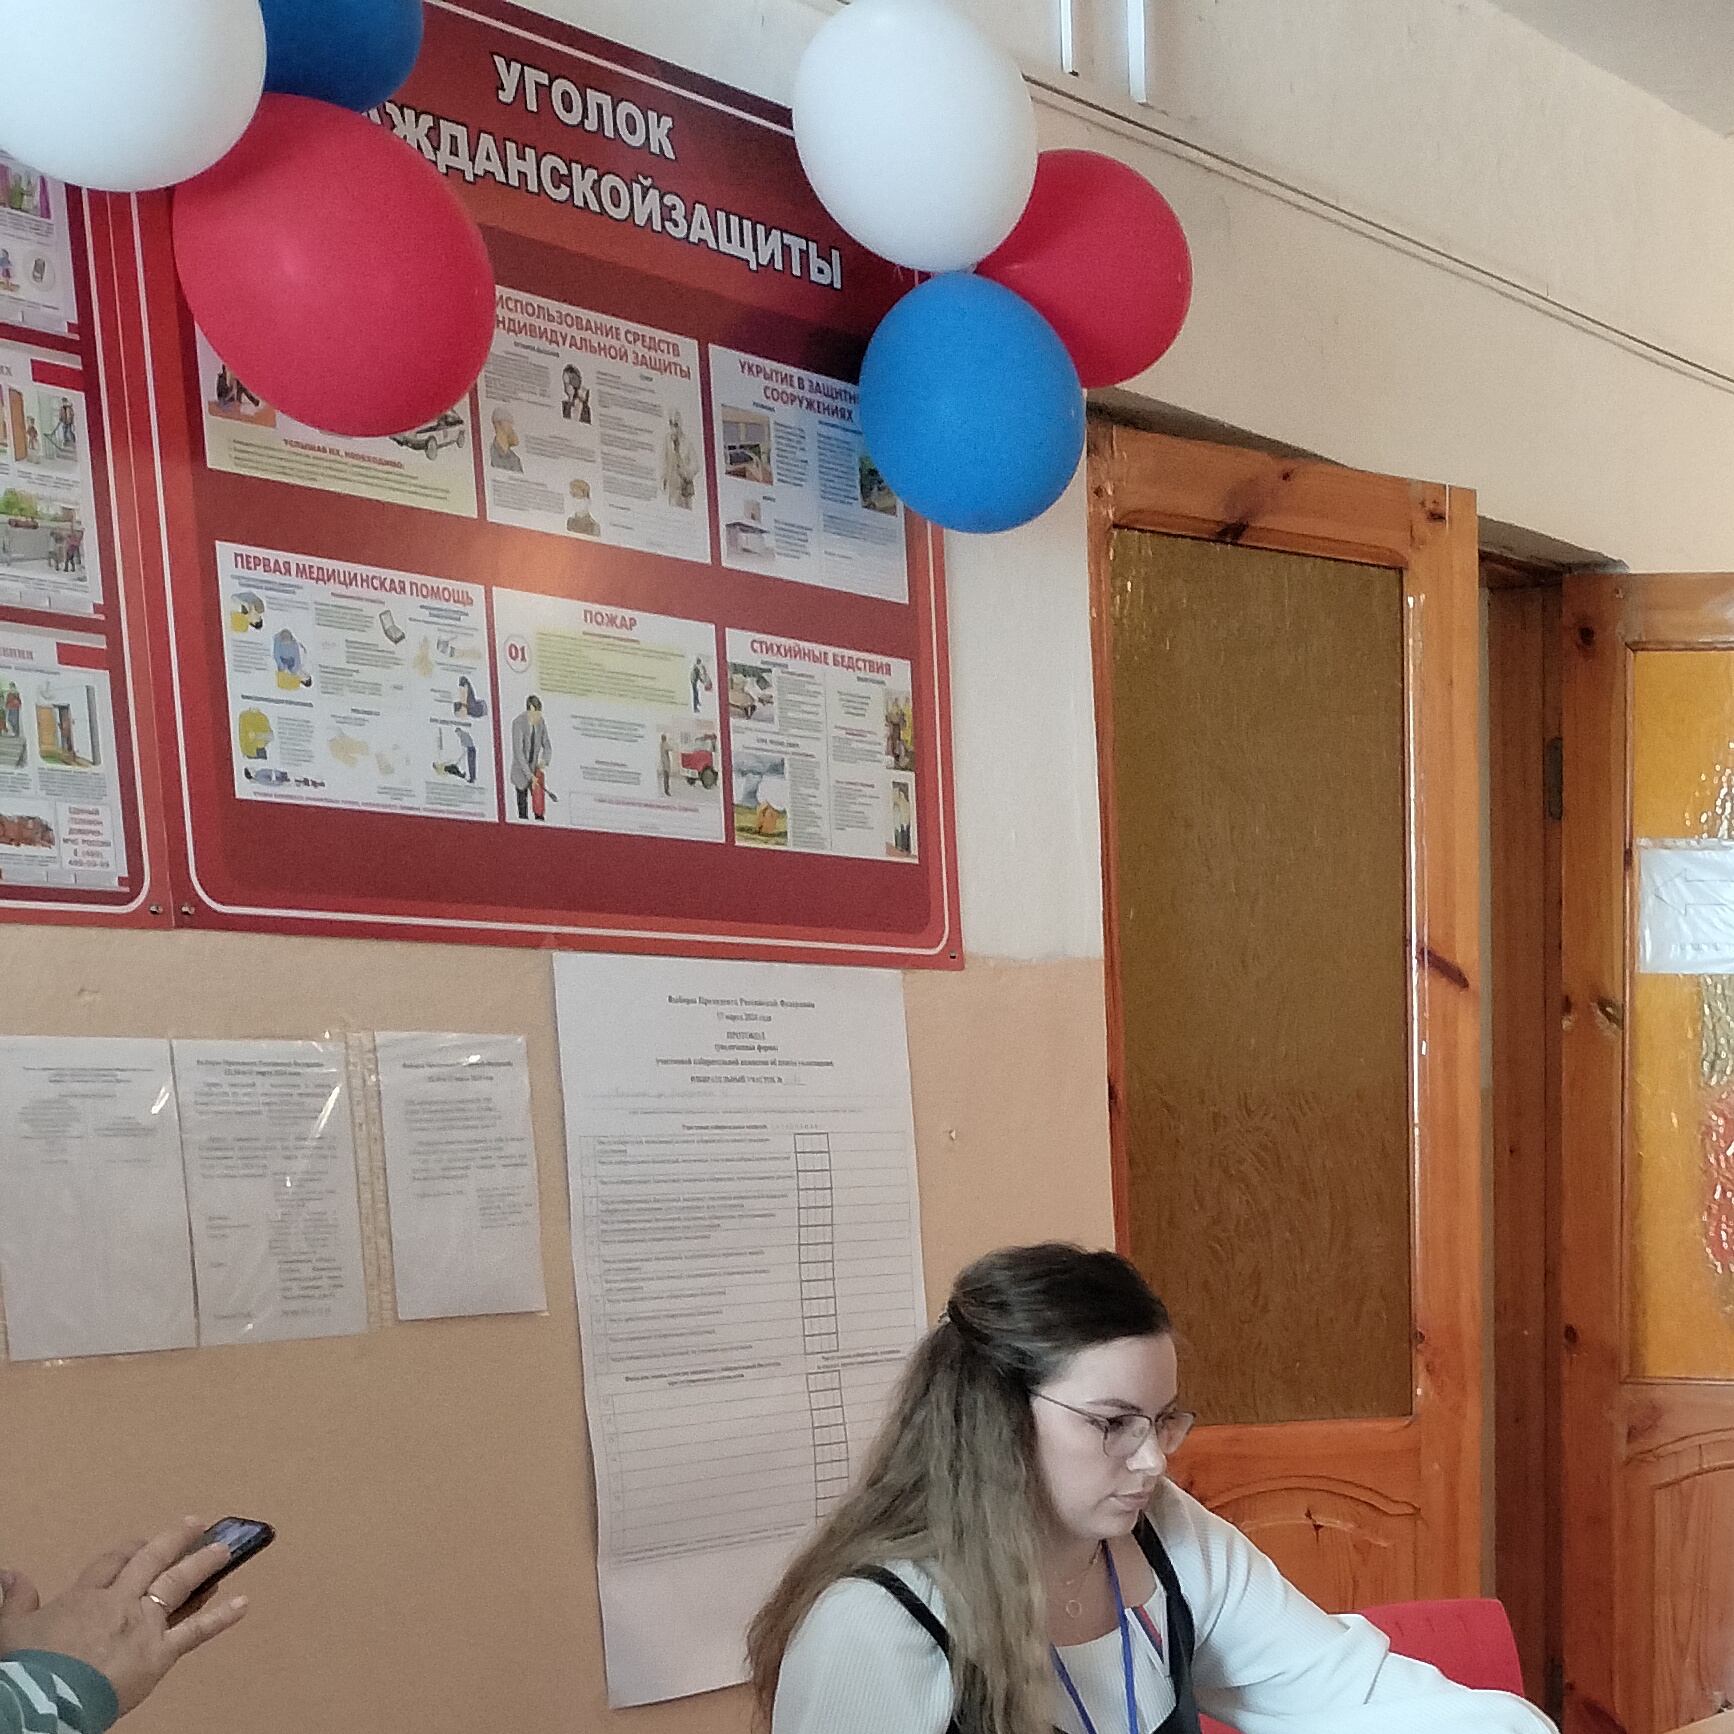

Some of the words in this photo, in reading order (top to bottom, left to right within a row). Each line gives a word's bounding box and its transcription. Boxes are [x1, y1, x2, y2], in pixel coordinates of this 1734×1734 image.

[493, 53, 676, 159] УГОЛОК
[361, 101, 842, 289] ЖДАНСКОЙЗАЩИТЫ
[496, 314, 628, 363] НДИВИДУАЛЬНОЙ
[632, 352, 691, 380] ЗАЩИТЫ
[497, 294, 621, 341] ИСПОЛЬЗОВАНИЕ
[625, 329, 681, 357] СРЕДСТВ
[738, 359, 795, 388] УКРЫТИЕ
[797, 377, 805, 390] В
[808, 380, 860, 405] ЗАЩИТН
[763, 386, 853, 423] СООРУЖЕНИЯХ
[233, 552, 292, 576] ПЕРВАЯ
[295, 562, 405, 595] МЕДИЦИНСКАЯ
[410, 583, 473, 606] ПОМОЩЬ
[583, 609, 637, 631] ПОЖАР
[508, 643, 527, 662] 01
[750, 639, 829, 667] СТИХИЙНЫЕ
[832, 653, 892, 676] БЕДСТВИЯ
